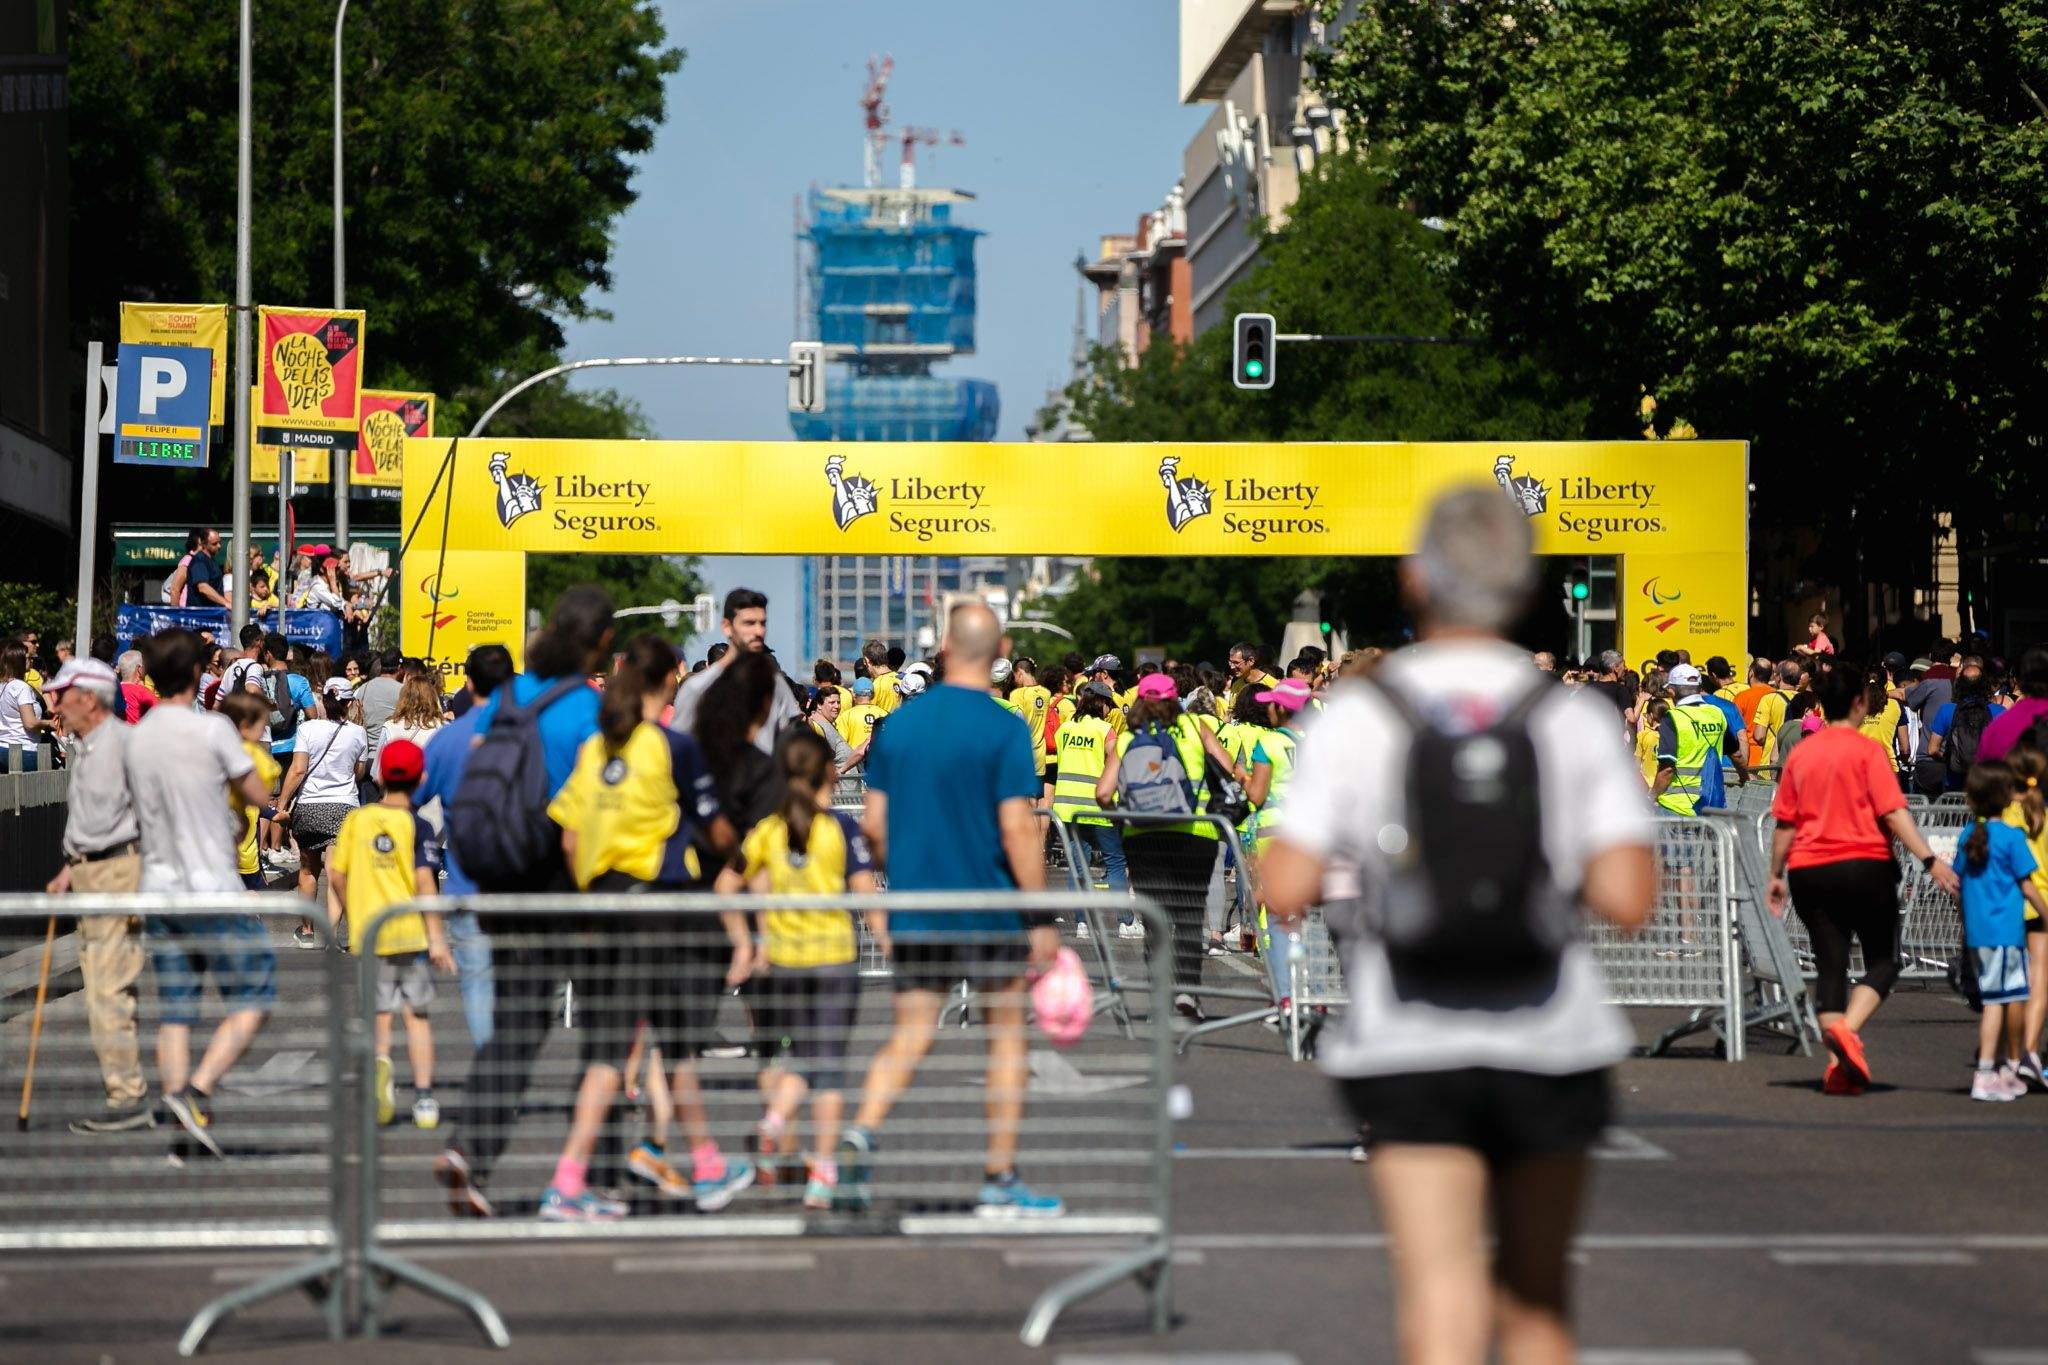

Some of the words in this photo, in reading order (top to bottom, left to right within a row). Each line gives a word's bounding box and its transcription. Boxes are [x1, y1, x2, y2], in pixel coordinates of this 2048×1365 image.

[290, 336, 307, 349] LA
[276, 342, 324, 368] NOCHE
[139, 356, 188, 415] P
[282, 367, 300, 382] DE
[302, 367, 331, 386] LAS
[288, 383, 332, 410] IDEAS
[376, 413, 390, 423] LA
[145, 425, 171, 434] FELIPE
[294, 433, 335, 445] MADRID
[138, 441, 195, 460] LIBRE
[386, 438, 402, 453] LA
[375, 451, 402, 472] IDEA
[555, 475, 651, 508] Liberty
[891, 477, 986, 510] Liberty
[1224, 478, 1320, 510] Liberty
[1560, 476, 1656, 509] Liberty
[131, 549, 142, 559] LA
[1068, 735, 1095, 748] ADM
